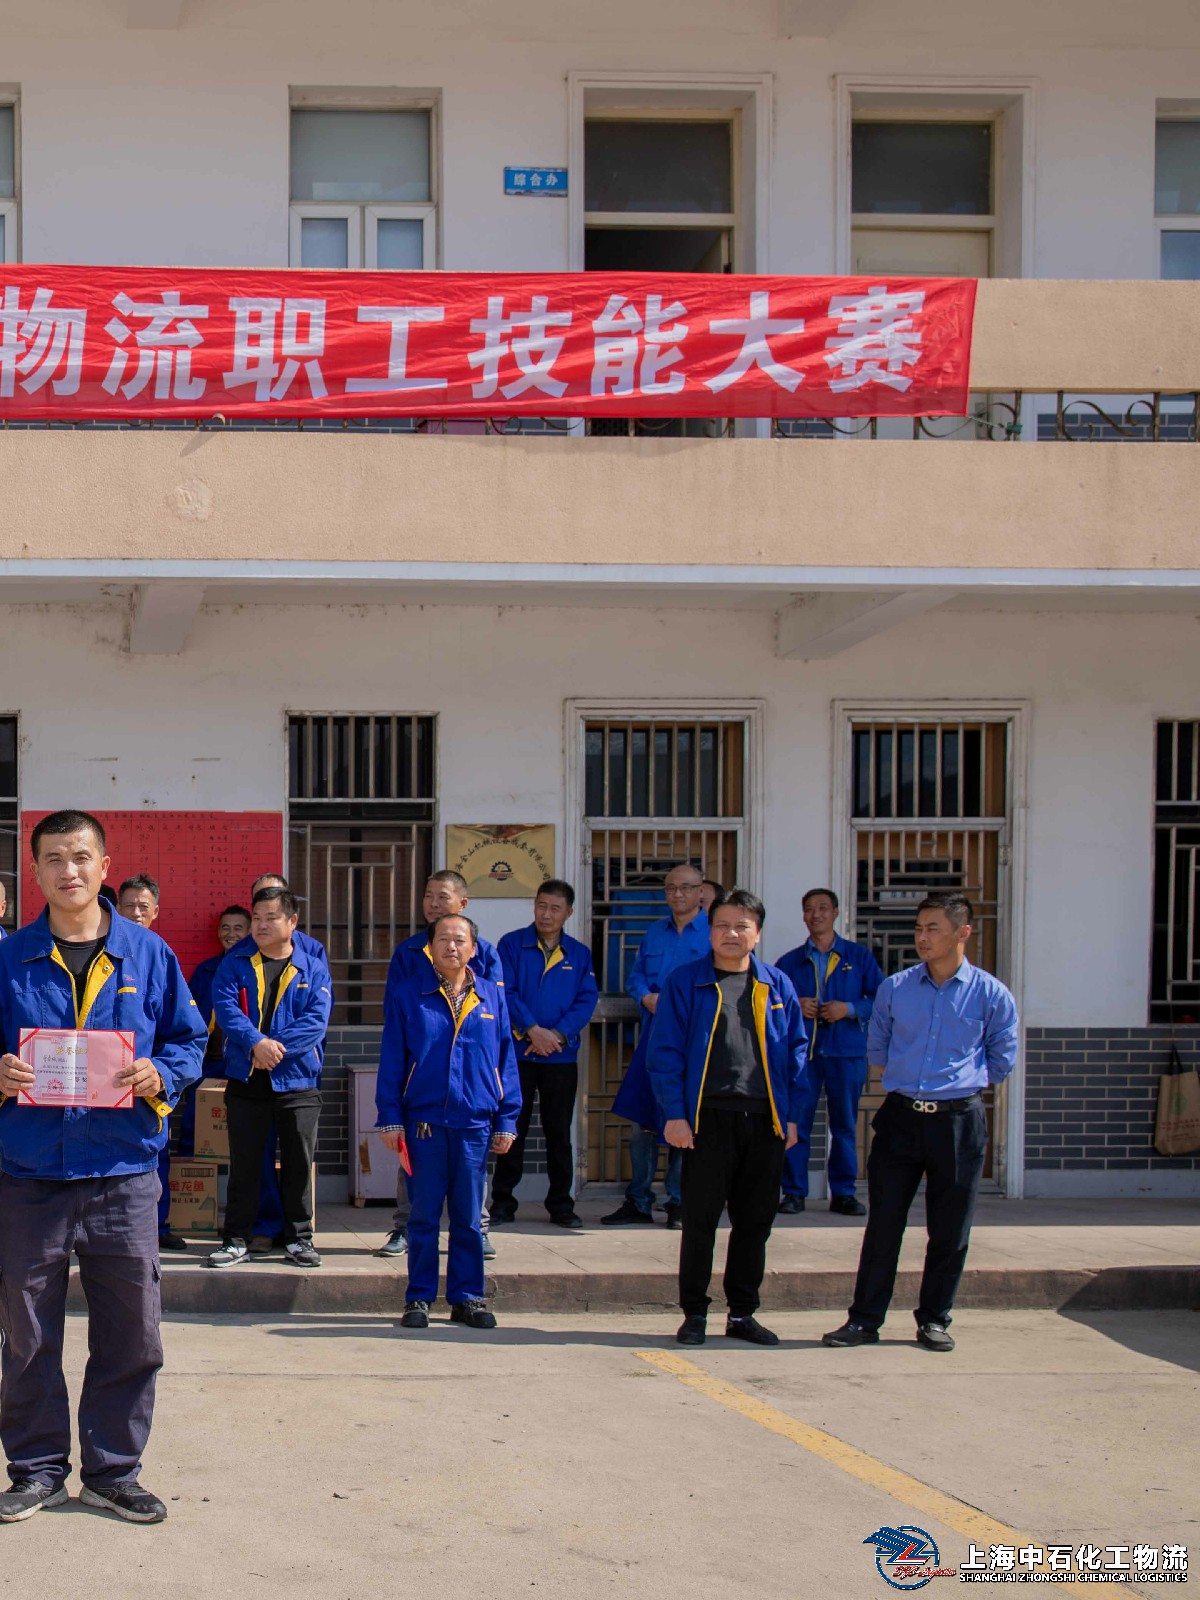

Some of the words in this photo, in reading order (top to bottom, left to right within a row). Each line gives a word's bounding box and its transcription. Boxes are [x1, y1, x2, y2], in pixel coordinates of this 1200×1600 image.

[513, 173, 559, 186] 综合办
[169, 1180, 205, 1192] 金龙鱼
